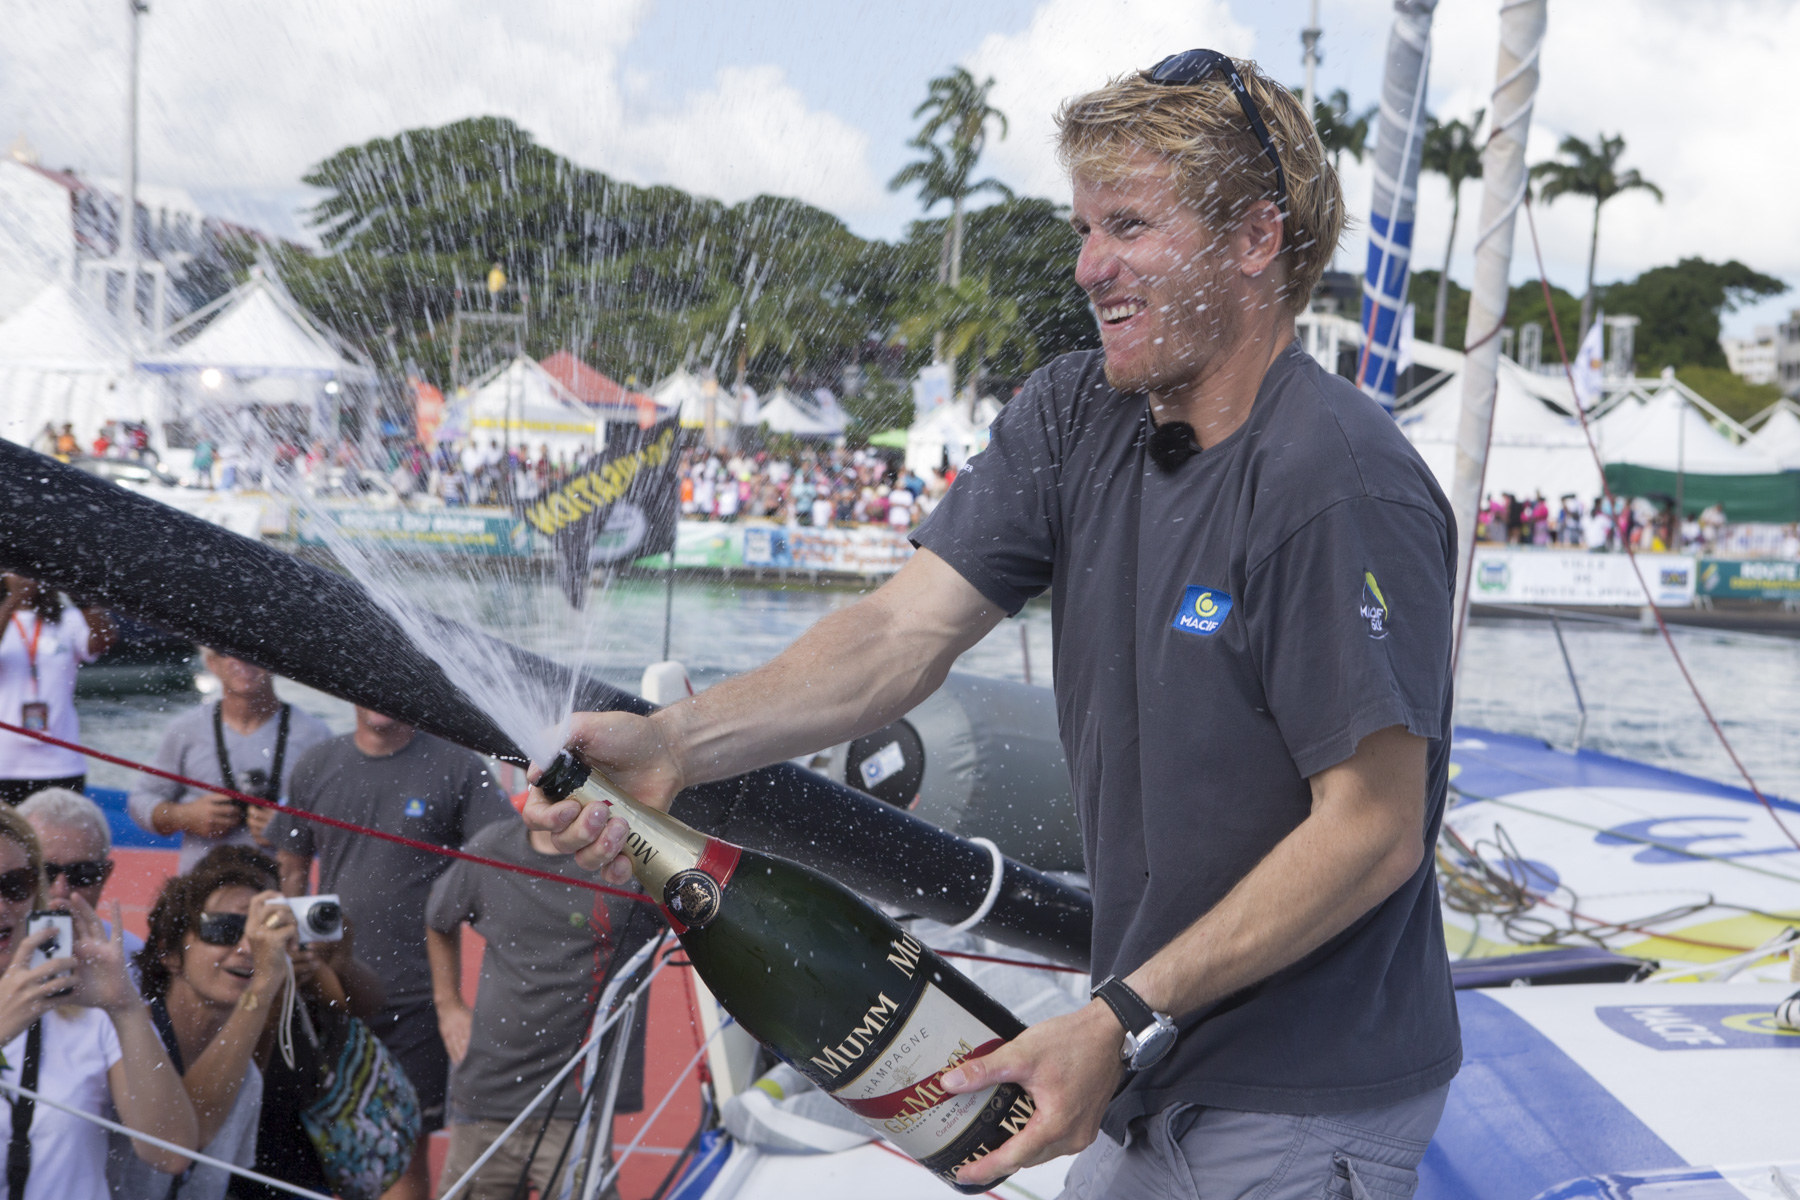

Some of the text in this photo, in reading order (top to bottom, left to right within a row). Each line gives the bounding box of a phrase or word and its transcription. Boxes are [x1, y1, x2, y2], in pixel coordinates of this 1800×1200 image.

[1180, 614, 1219, 632] MACIF
[809, 991, 900, 1079] MUMM
[860, 1027, 930, 1099] CHAMPAGNE
[941, 1102, 961, 1123] BRUT
